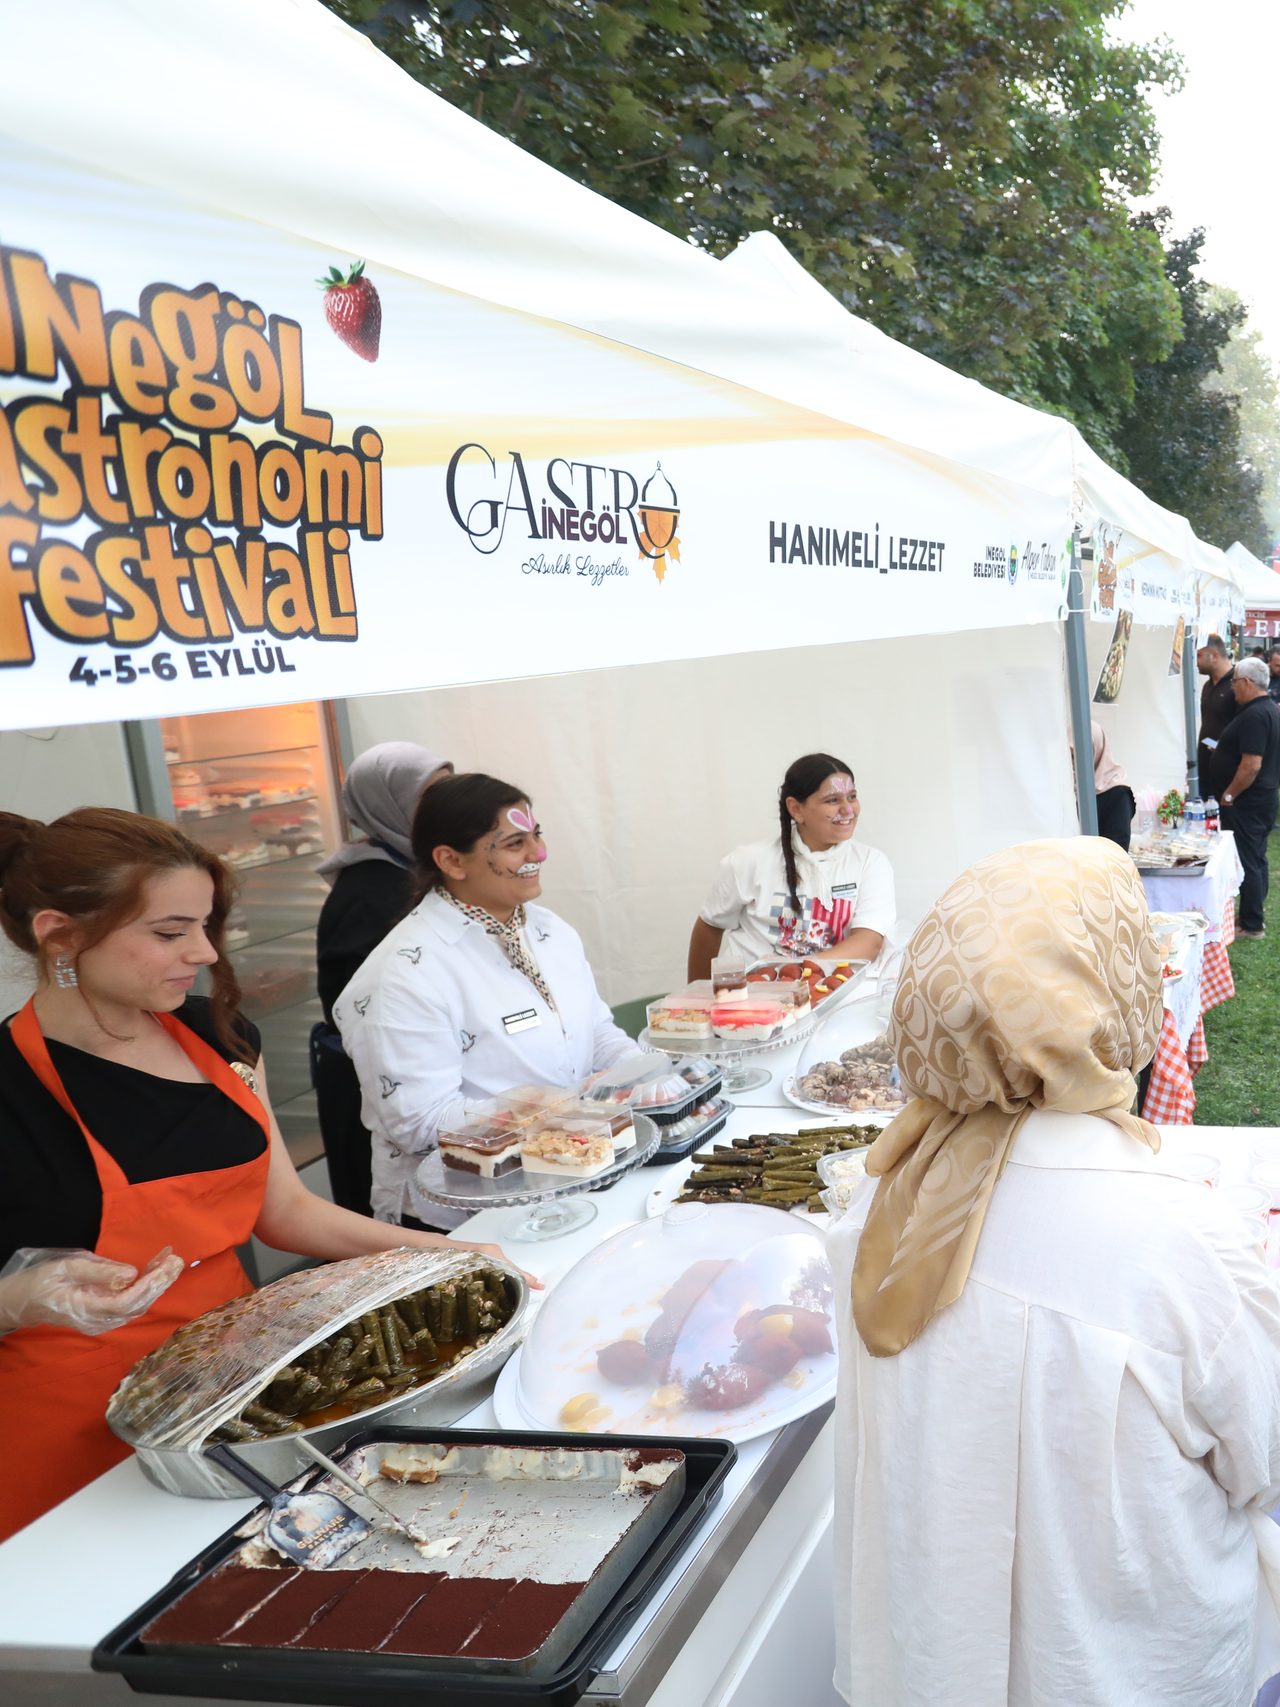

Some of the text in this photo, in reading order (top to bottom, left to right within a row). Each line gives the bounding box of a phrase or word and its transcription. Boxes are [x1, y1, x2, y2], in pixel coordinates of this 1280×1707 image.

[541, 498, 628, 544] İNEGÖL
[69, 639, 296, 686] 4-5-6 EYLÜL
